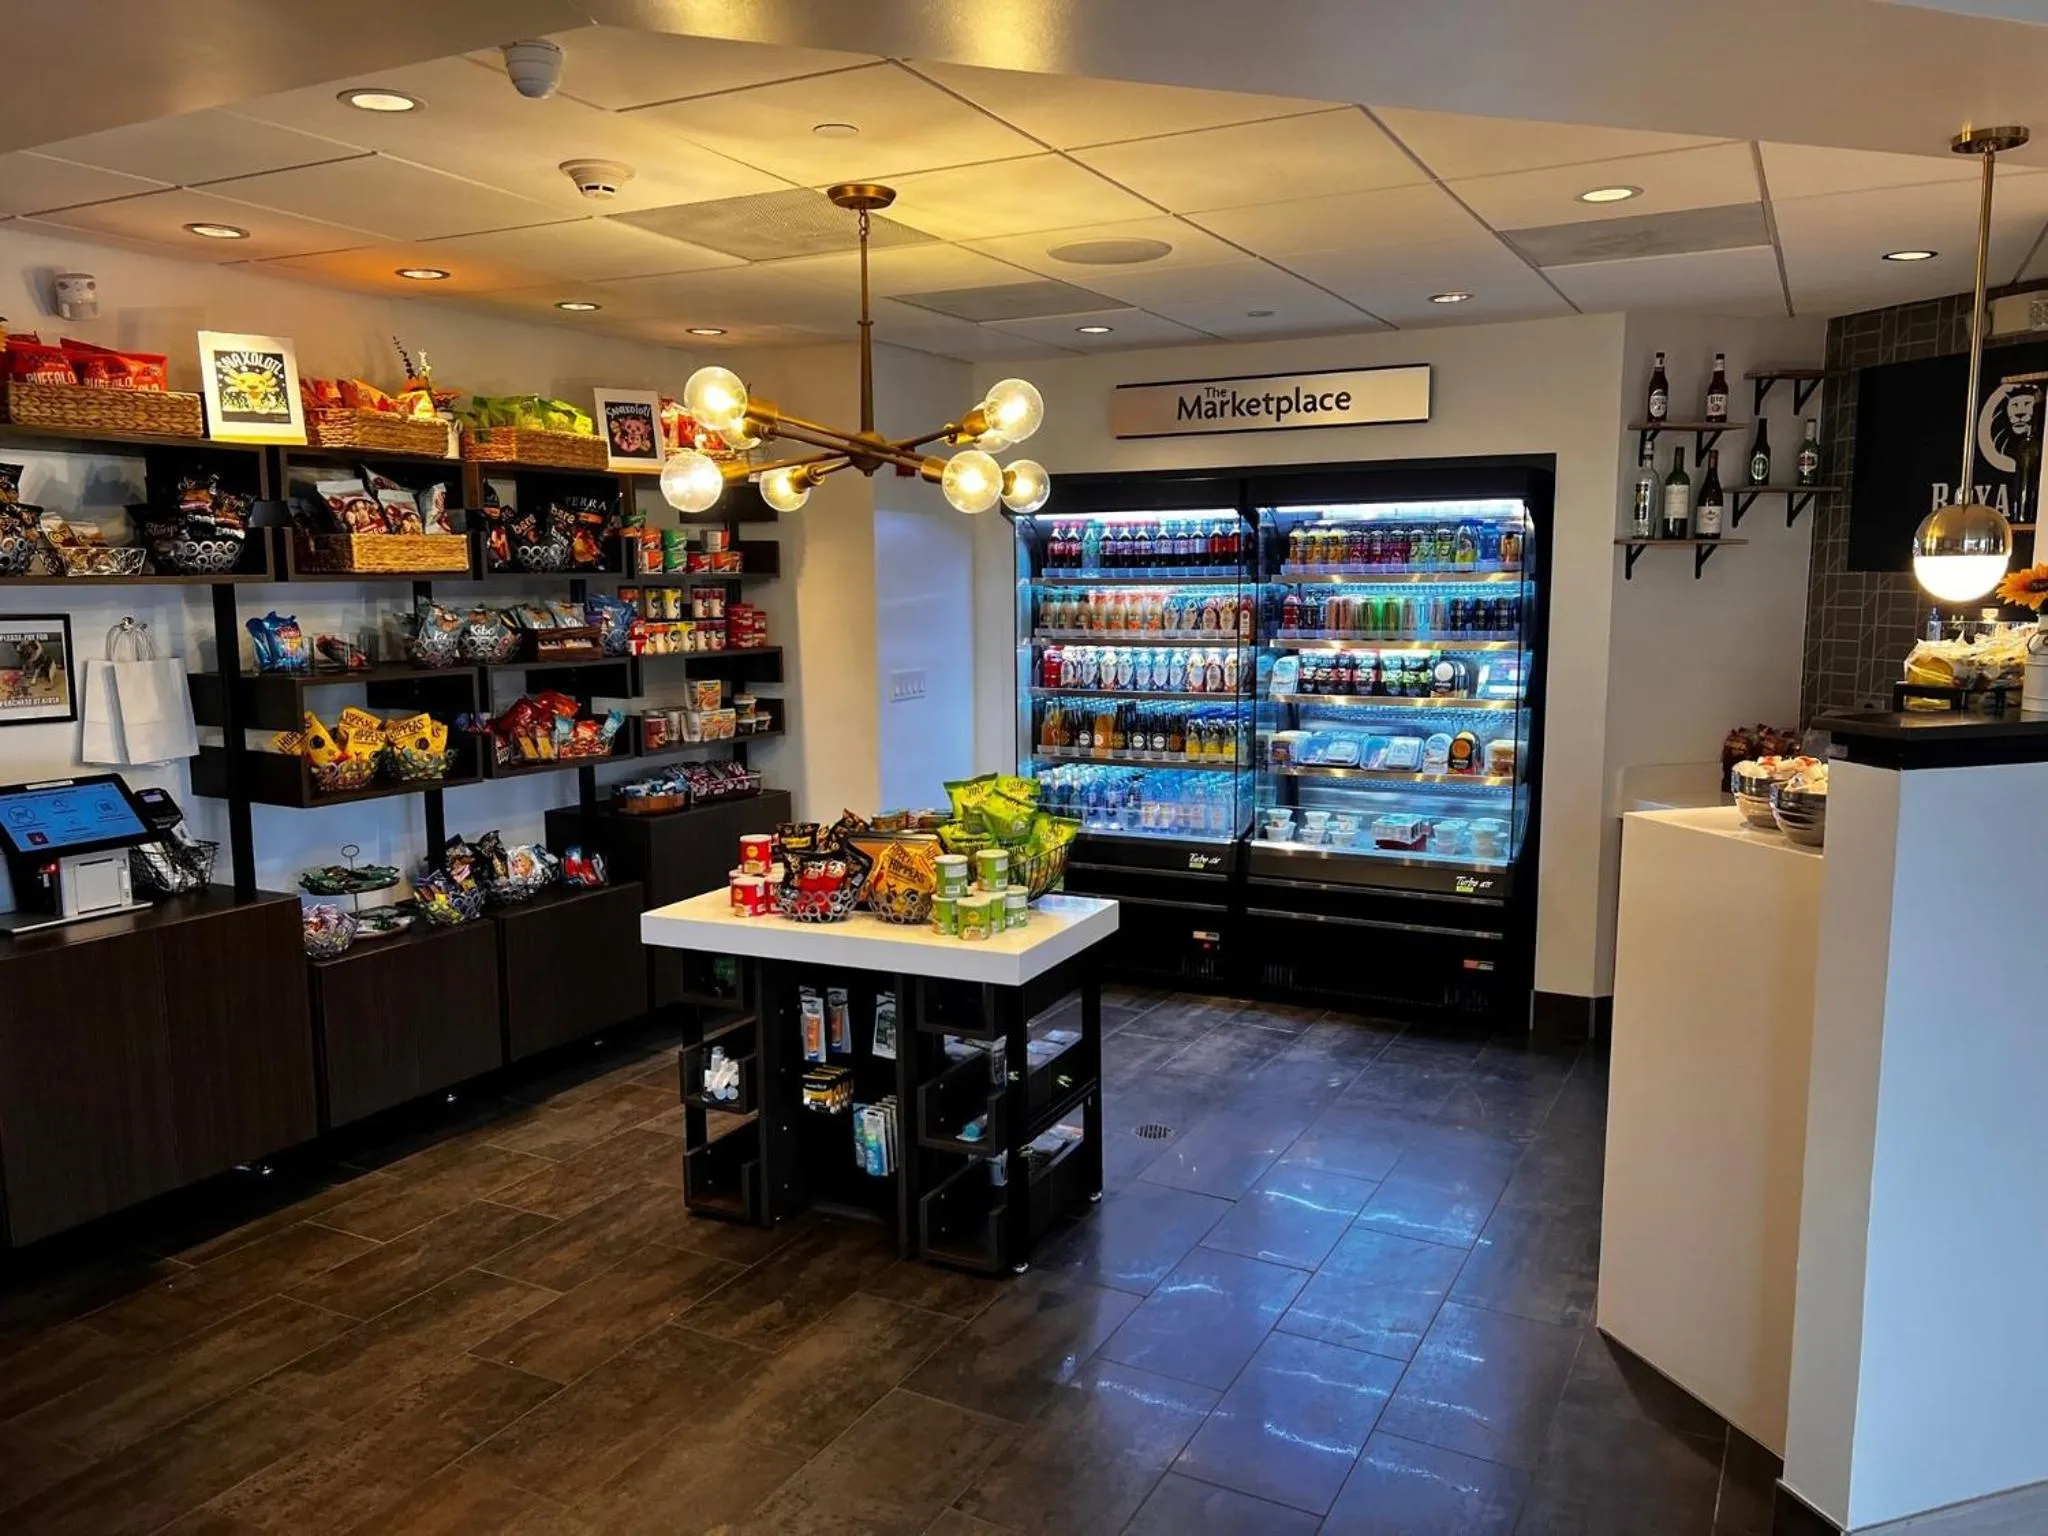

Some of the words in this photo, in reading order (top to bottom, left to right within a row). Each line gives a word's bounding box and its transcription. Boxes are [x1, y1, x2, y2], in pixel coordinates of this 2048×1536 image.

[216, 351, 283, 374] SNAXOLOTL
[1177, 386, 1352, 422] Marketplace
[1204, 386, 1228, 400] The
